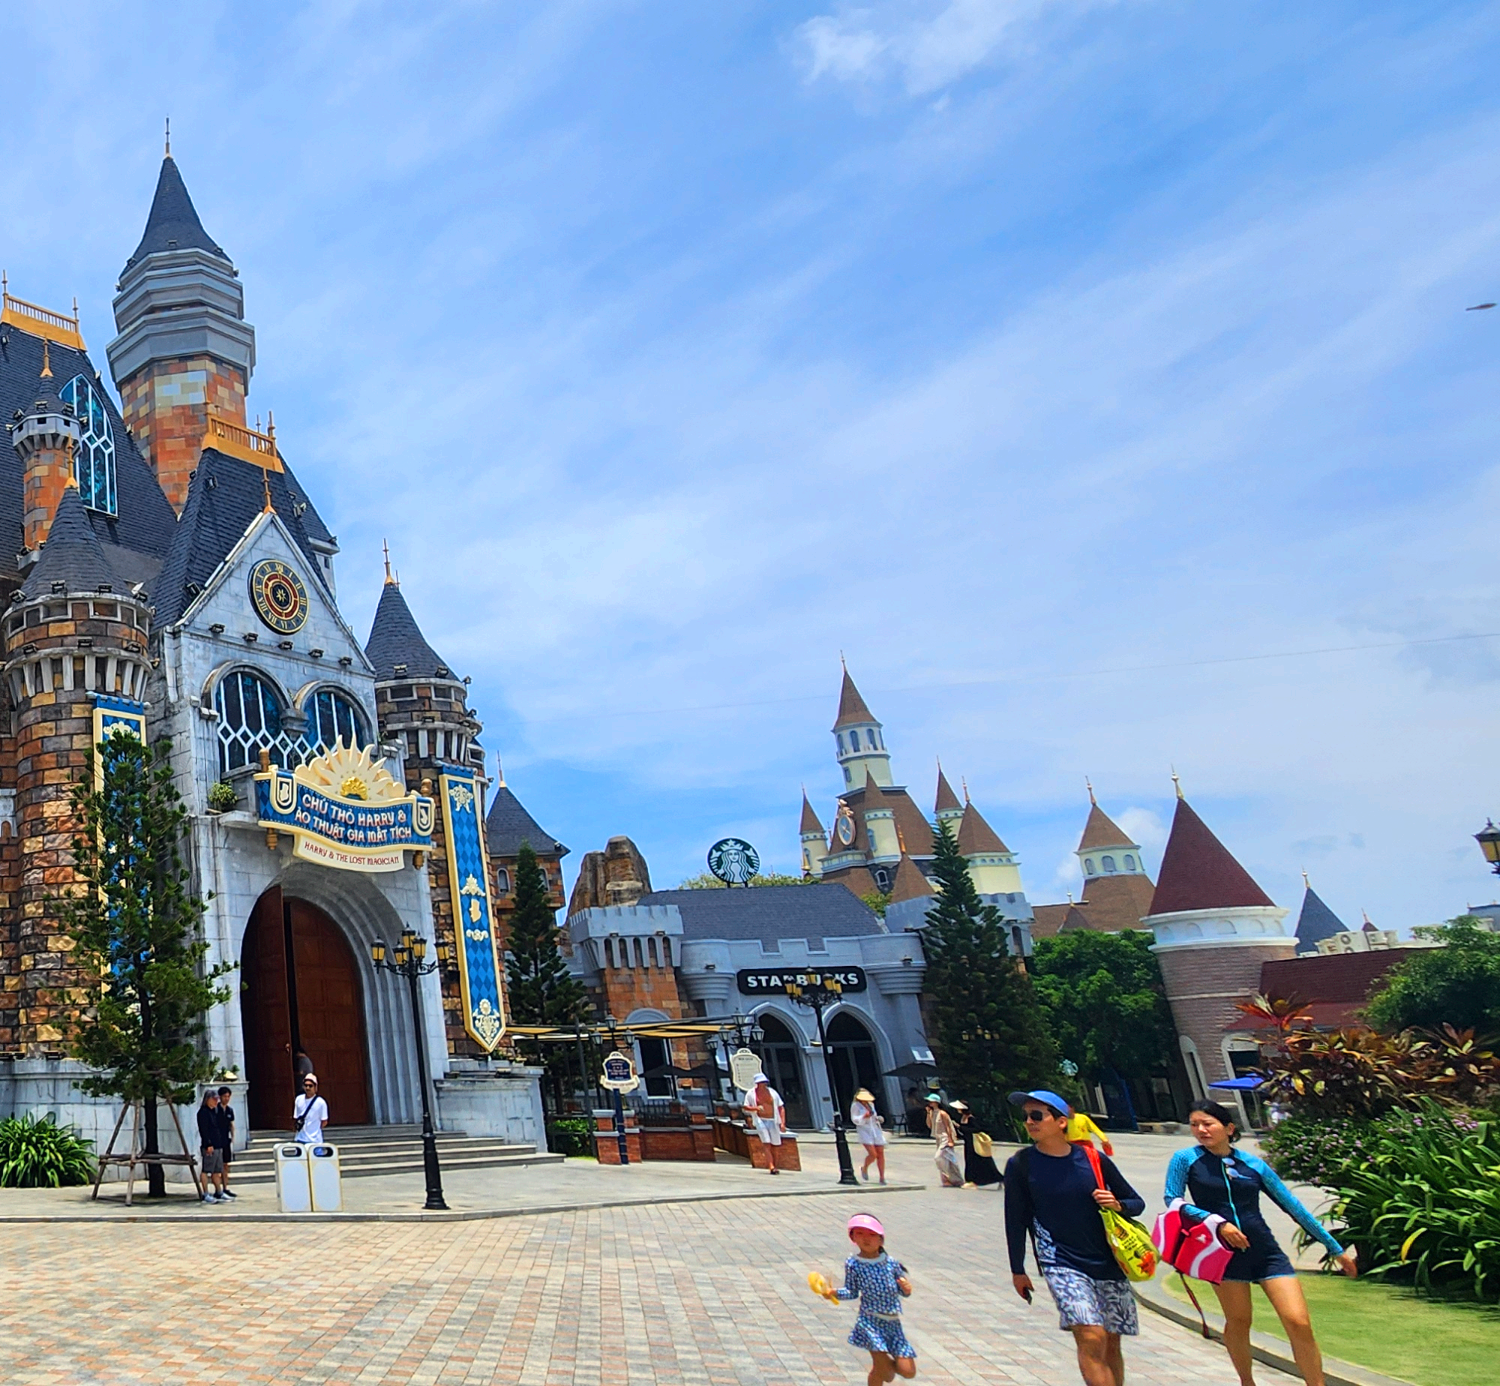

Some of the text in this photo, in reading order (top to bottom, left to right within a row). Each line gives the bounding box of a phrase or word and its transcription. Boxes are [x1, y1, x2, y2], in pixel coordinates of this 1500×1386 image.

[295, 806, 311, 824] ẢO
[313, 815, 345, 839] THUẬT
[347, 829, 365, 842] GIA
[390, 825, 412, 839] TÍCH
[302, 794, 406, 827] CHÚ THỎ HARRY &
[304, 841, 399, 865] HARRY & THE LOST MAGICIAN
[747, 973, 859, 988] STABKS
